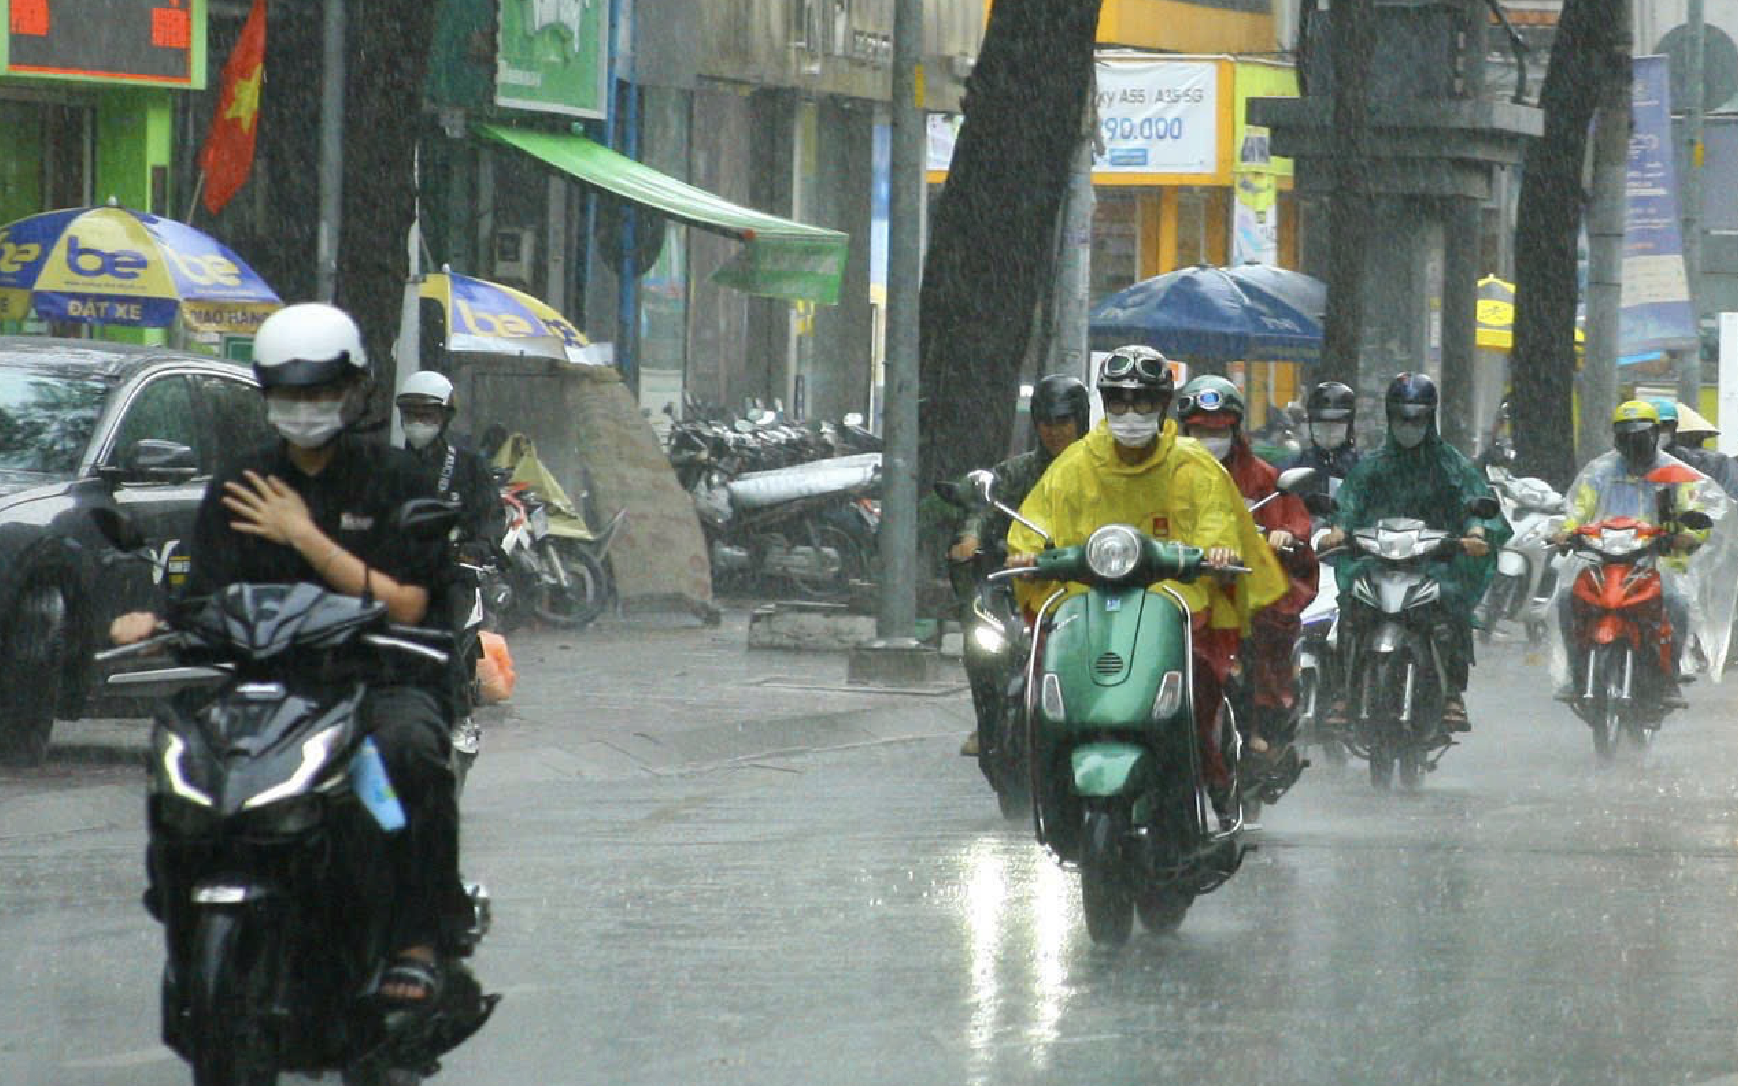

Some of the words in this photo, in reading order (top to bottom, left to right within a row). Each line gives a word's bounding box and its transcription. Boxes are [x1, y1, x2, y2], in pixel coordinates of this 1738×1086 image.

[1101, 117, 1182, 140] 90.000
[66, 235, 147, 279] be
[114, 303, 142, 319] XE
[457, 299, 534, 337] be
